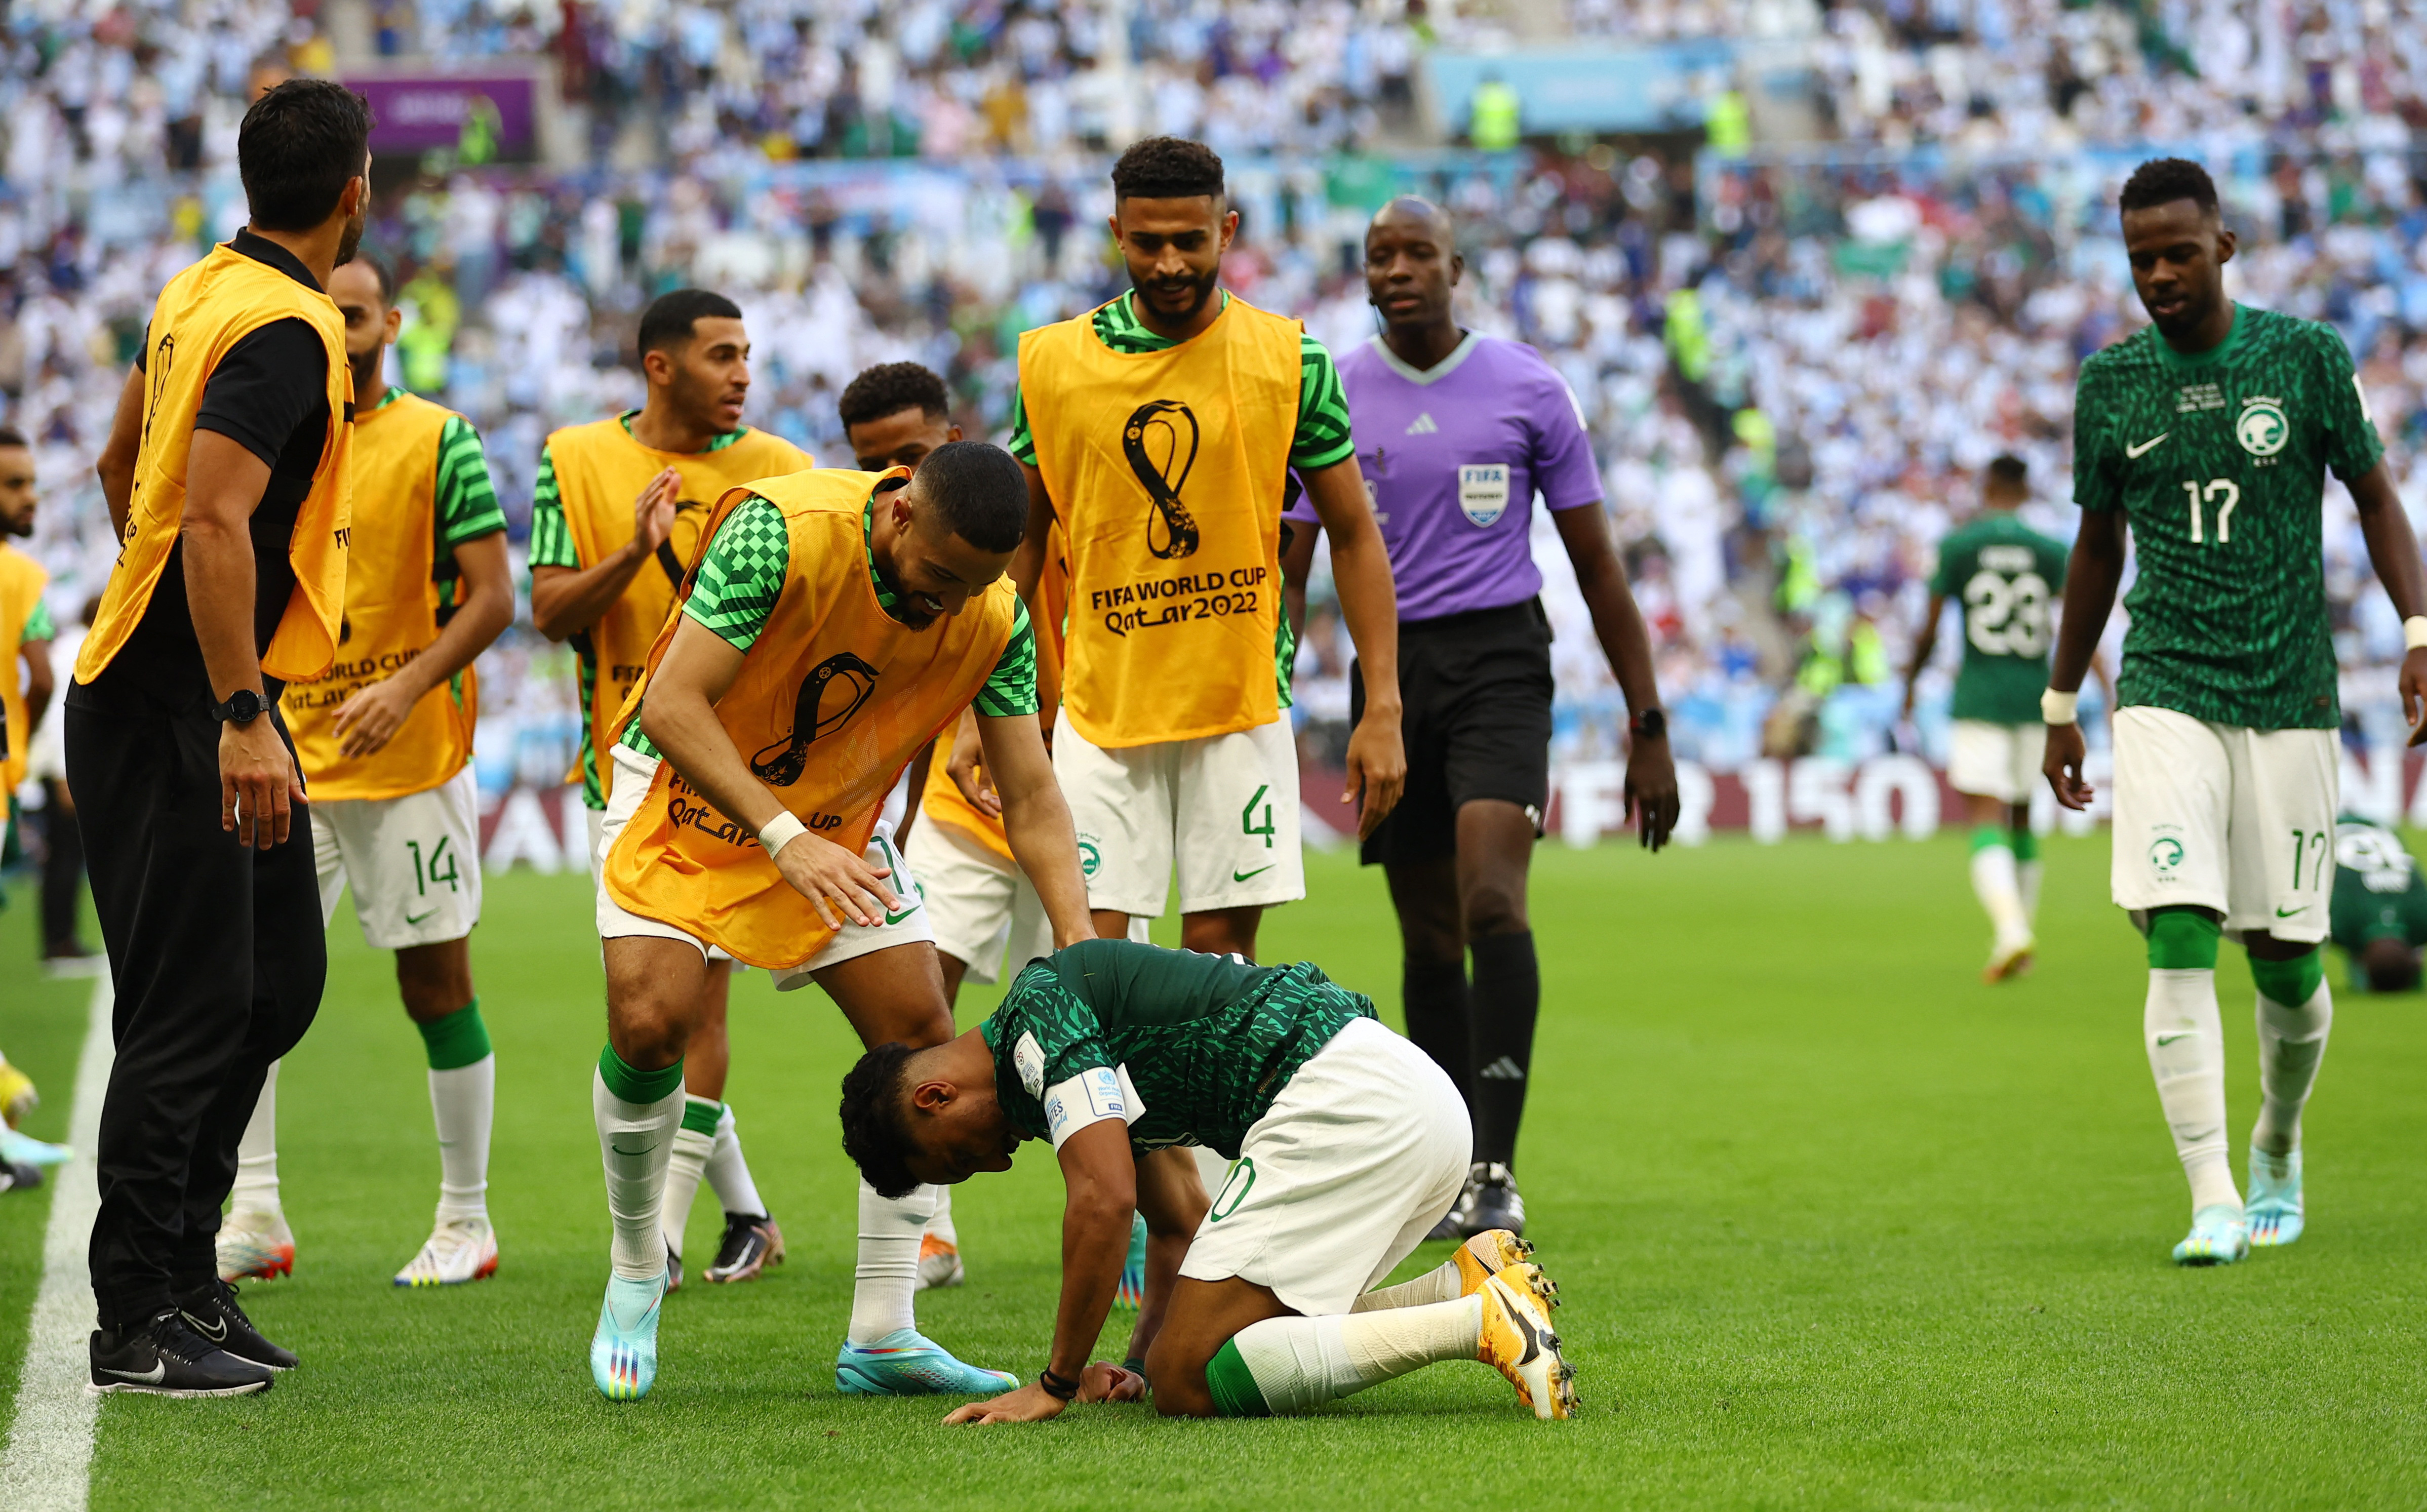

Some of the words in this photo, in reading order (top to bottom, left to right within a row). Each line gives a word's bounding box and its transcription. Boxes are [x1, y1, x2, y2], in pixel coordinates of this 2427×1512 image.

[1465, 469, 1503, 482] FIFA
[2182, 478, 2240, 543] 17
[1092, 586, 1134, 610] FIFA
[1137, 573, 1224, 601] WORLD
[1230, 567, 1266, 587] CUP
[1963, 570, 2053, 659] 23
[317, 658, 376, 682] ORLD
[668, 798, 761, 847] Qatar
[800, 812, 843, 830] UP
[1242, 785, 1275, 848] 4
[406, 835, 458, 896] 14
[2292, 829, 2327, 892] 17
[1211, 1157, 1256, 1222] 0
